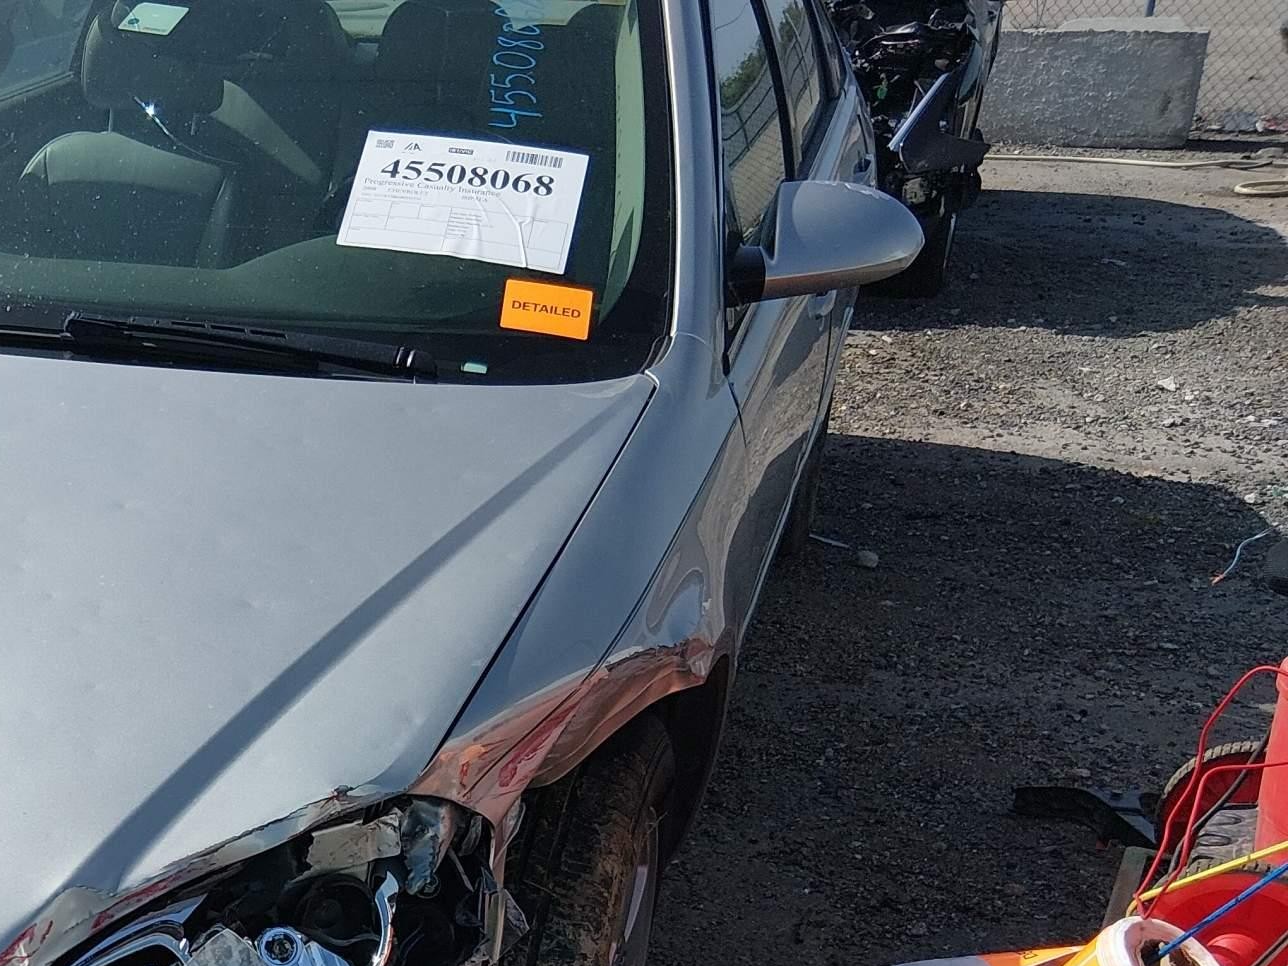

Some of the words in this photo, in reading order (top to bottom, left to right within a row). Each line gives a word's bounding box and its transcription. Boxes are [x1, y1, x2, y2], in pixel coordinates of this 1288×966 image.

[488, 7, 544, 127] 455080
[365, 178, 414, 188] Progressive
[417, 183, 455, 193] Casualty
[380, 159, 554, 196] 45508068
[512, 300, 581, 318] DETAILED
